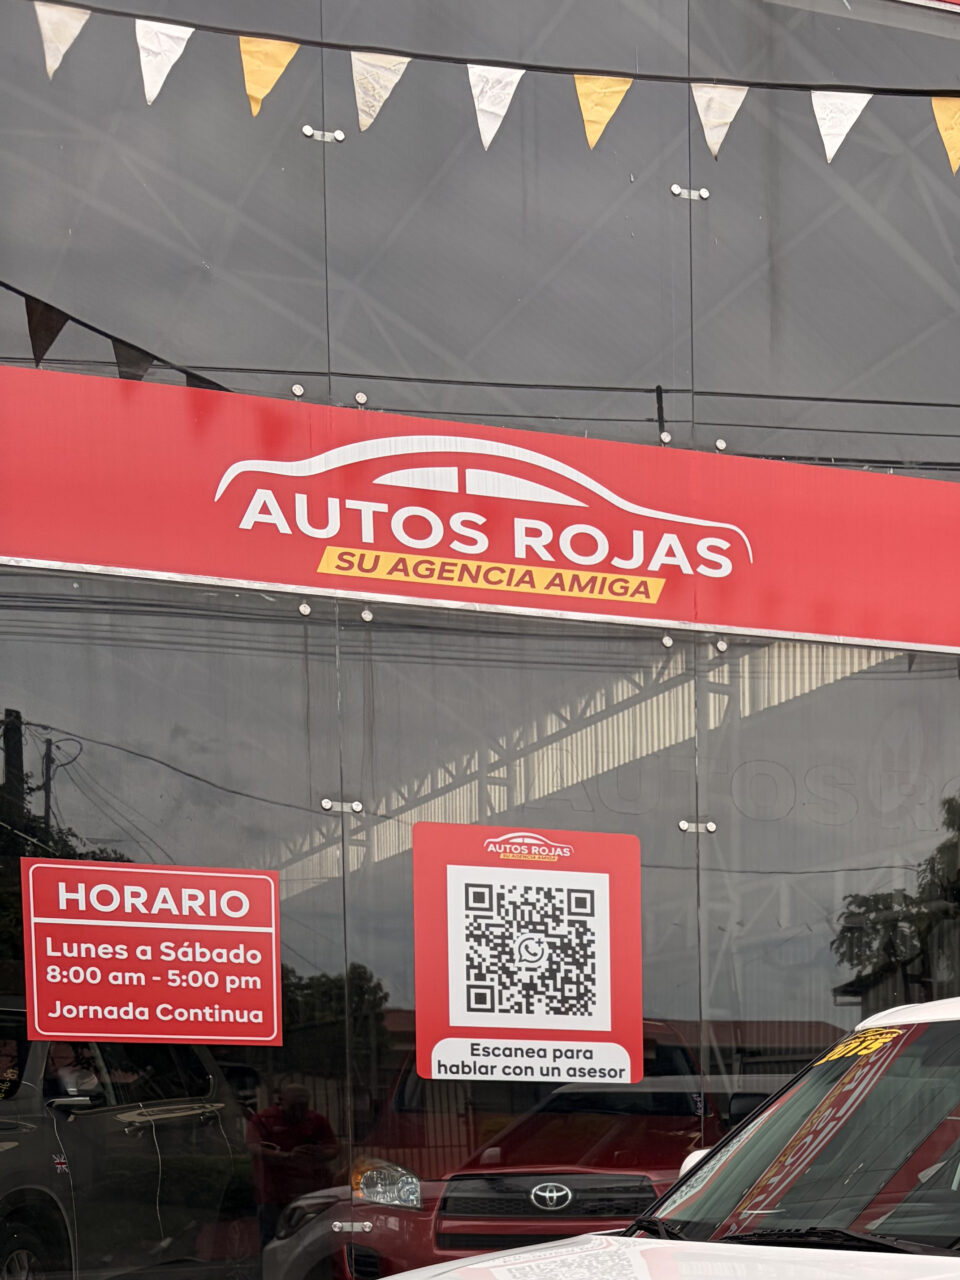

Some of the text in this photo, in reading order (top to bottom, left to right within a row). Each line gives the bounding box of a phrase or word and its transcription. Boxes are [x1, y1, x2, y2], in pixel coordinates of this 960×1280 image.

[238, 488, 733, 578] AUTOS ROJAS
[335, 551, 651, 599] SU AGENCIA AMIGA
[487, 844, 571, 857] AUTOS ROJAS
[57, 881, 250, 918] HORARIO
[46, 936, 262, 965] Lunes a Sábado
[46, 965, 102, 984] 8:00
[108, 970, 146, 986] am
[167, 969, 219, 988] 5:00
[225, 975, 262, 993] pm
[48, 1000, 263, 1023] Jornada Continua
[470, 1043, 593, 1063] Escanea para
[437, 1060, 626, 1079] hablar con un asesor
